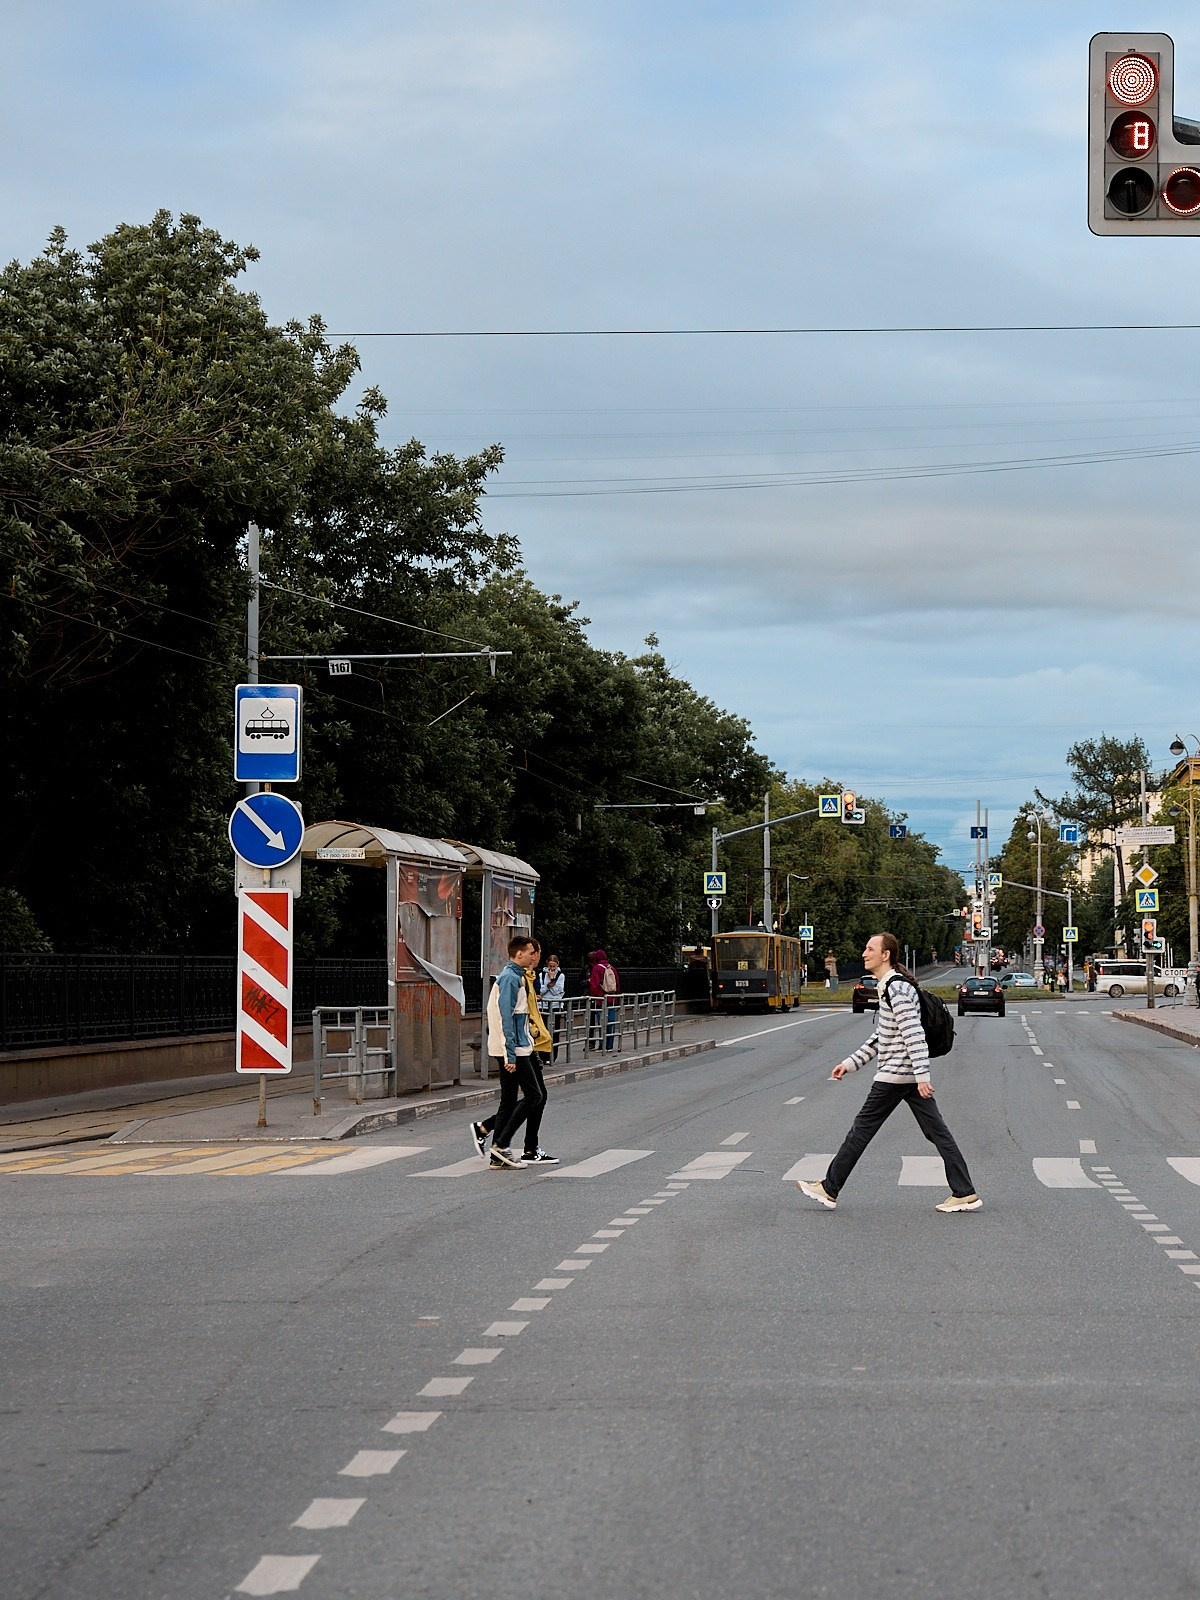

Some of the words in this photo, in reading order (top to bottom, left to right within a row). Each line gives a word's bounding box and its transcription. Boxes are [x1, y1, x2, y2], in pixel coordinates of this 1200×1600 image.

[1134, 122, 1149, 149] 8
[330, 663, 350, 673] 1167
[739, 962, 747, 970] 16
